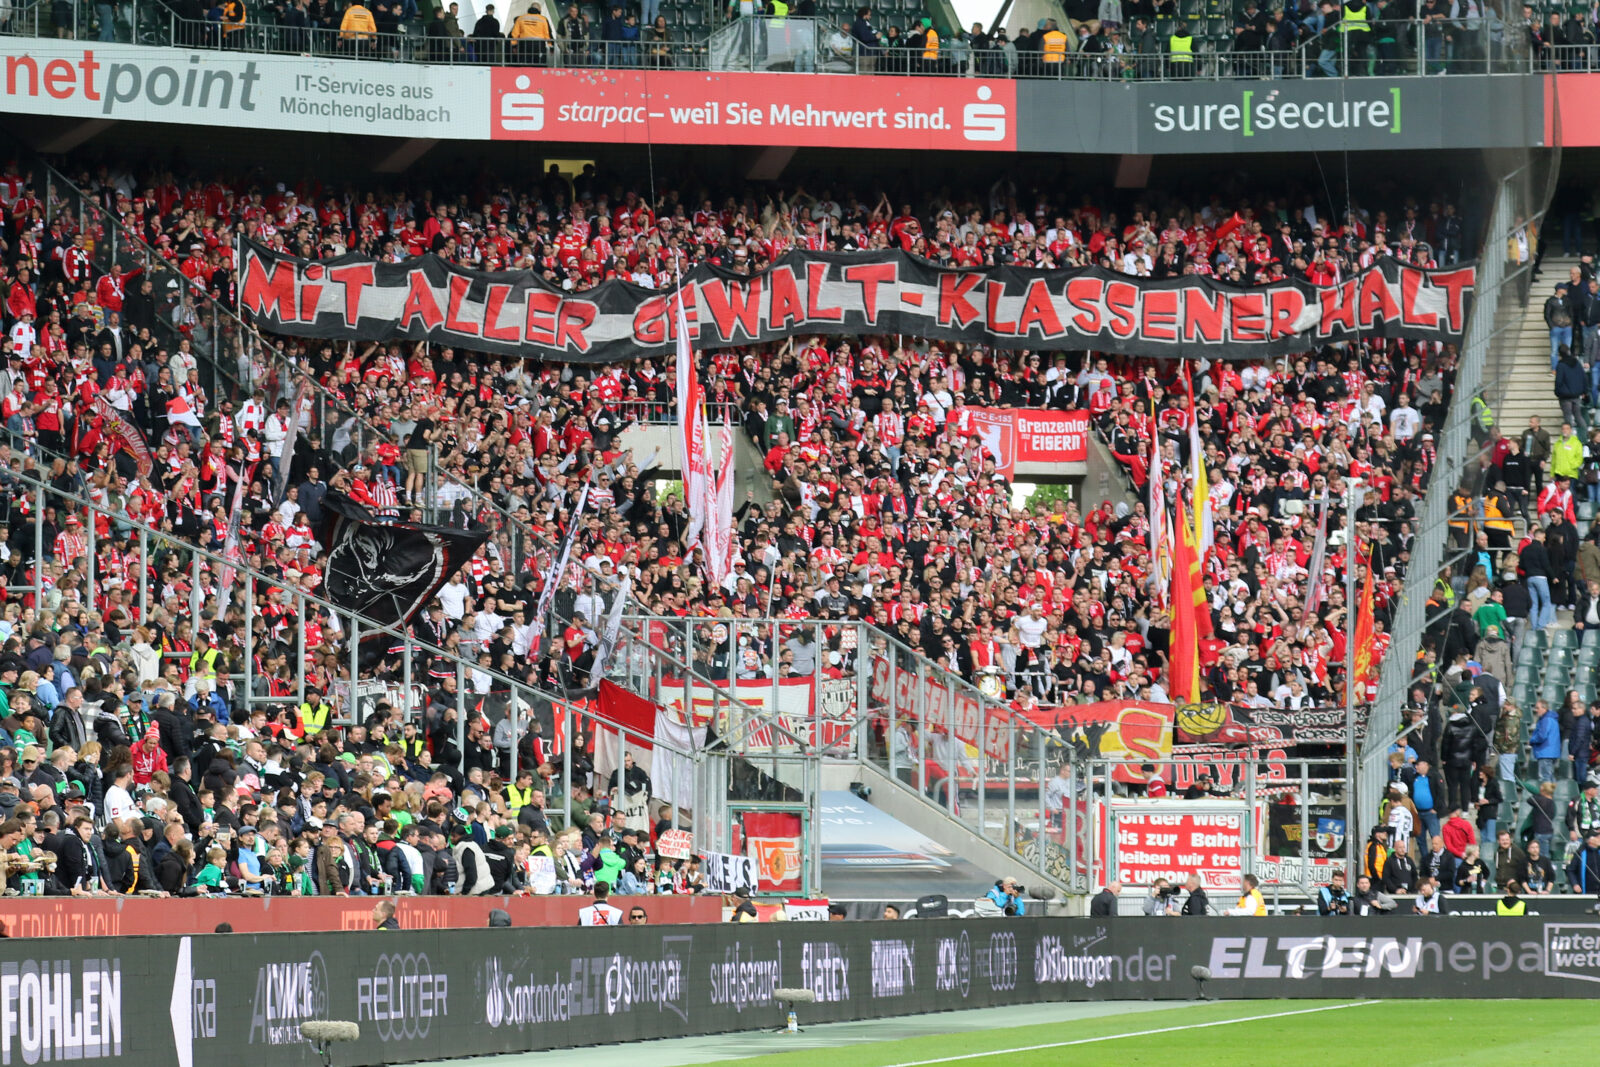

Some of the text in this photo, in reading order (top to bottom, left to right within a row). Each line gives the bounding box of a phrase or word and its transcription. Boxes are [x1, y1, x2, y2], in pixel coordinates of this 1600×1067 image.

[5, 50, 261, 114] netpoint
[295, 74, 434, 99] IT-Services aus
[280, 96, 452, 123] Mönchengladbach
[557, 99, 646, 128] starpac
[669, 101, 719, 126] weil
[725, 102, 763, 126] Sie
[769, 102, 887, 129] Mehrwert
[893, 105, 951, 131] sind.
[397, 266, 597, 354] ALLER
[1173, 750, 1288, 790] DEVILS
[1119, 850, 1172, 865] leiben
[1177, 853, 1205, 866] wir
[1145, 833, 1178, 847] zur
[1, 958, 122, 1065] FOHLEN
[357, 973, 448, 1021] REUTER
[505, 971, 573, 1026] Santander
